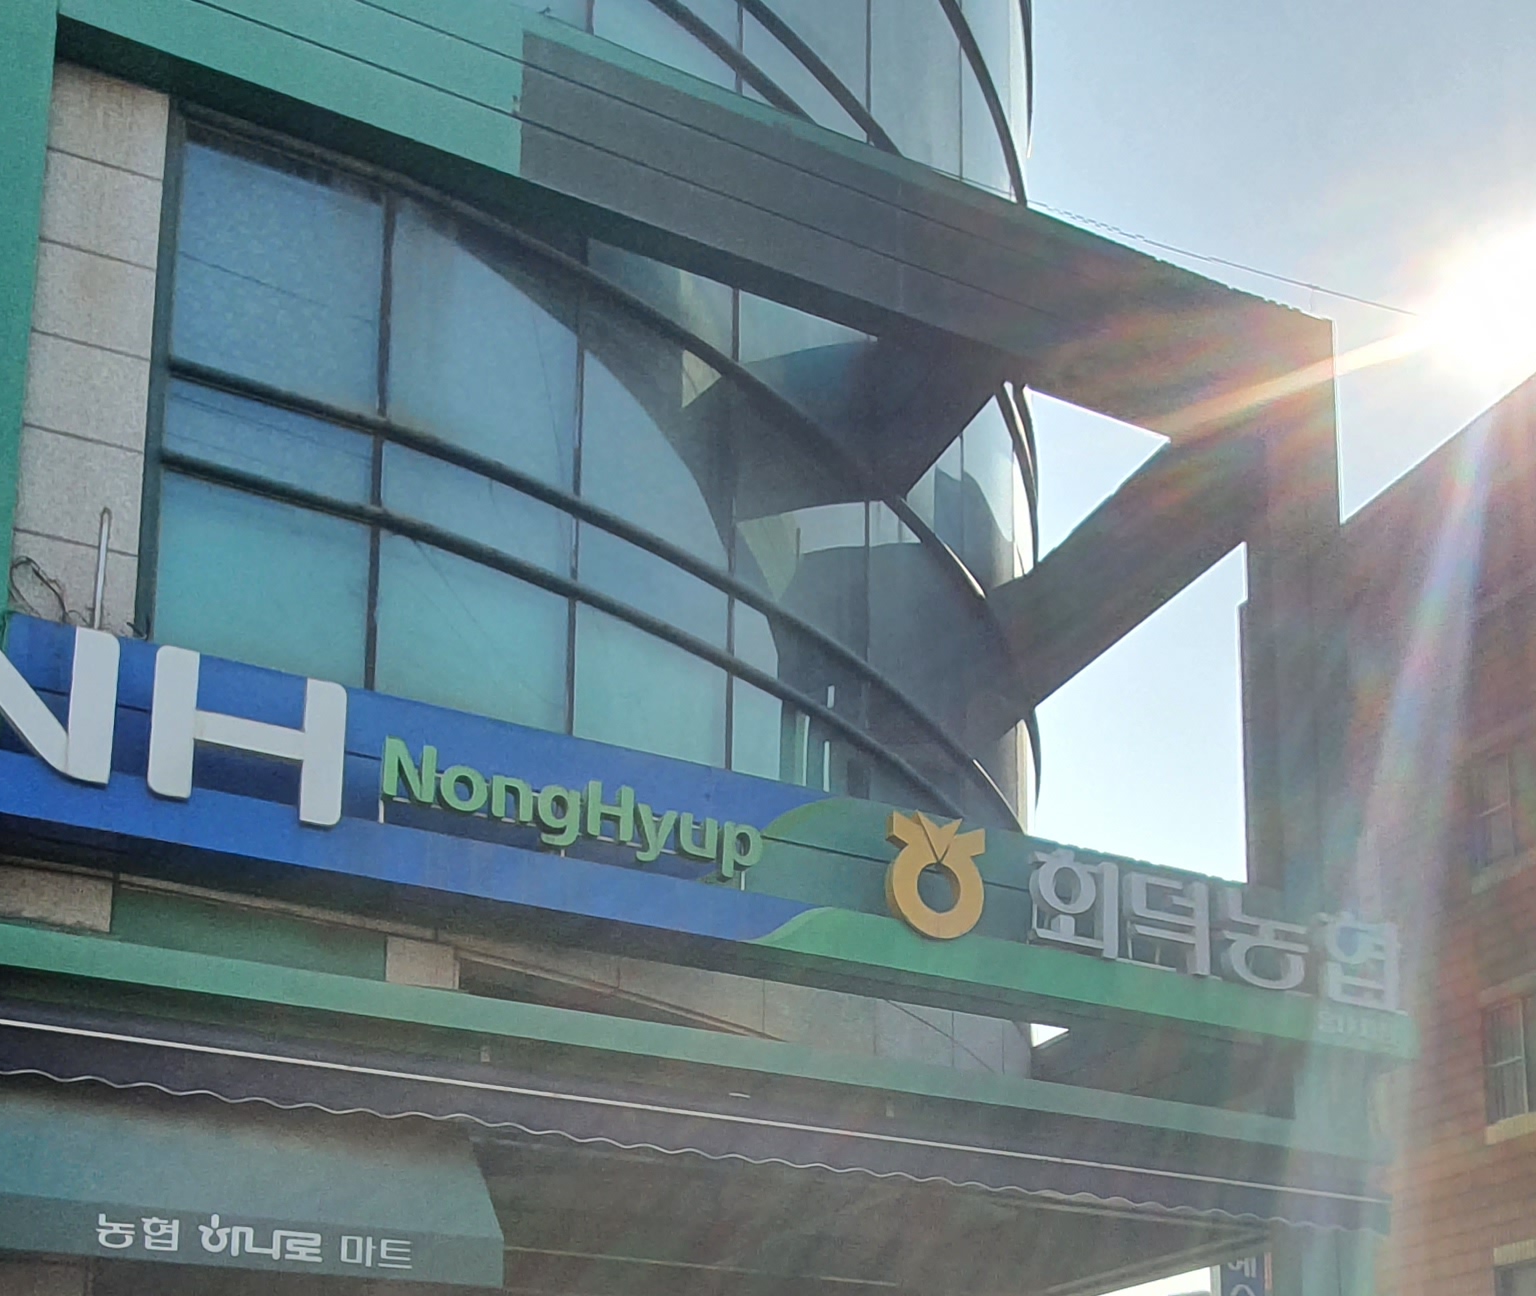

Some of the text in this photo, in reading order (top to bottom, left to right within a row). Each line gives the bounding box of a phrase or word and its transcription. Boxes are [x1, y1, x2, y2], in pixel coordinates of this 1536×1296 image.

[382, 734, 764, 880] NongHyup
[1027, 846, 1402, 1014] 회덕농협
[94, 1212, 413, 1270] 농협 하나로 마트
